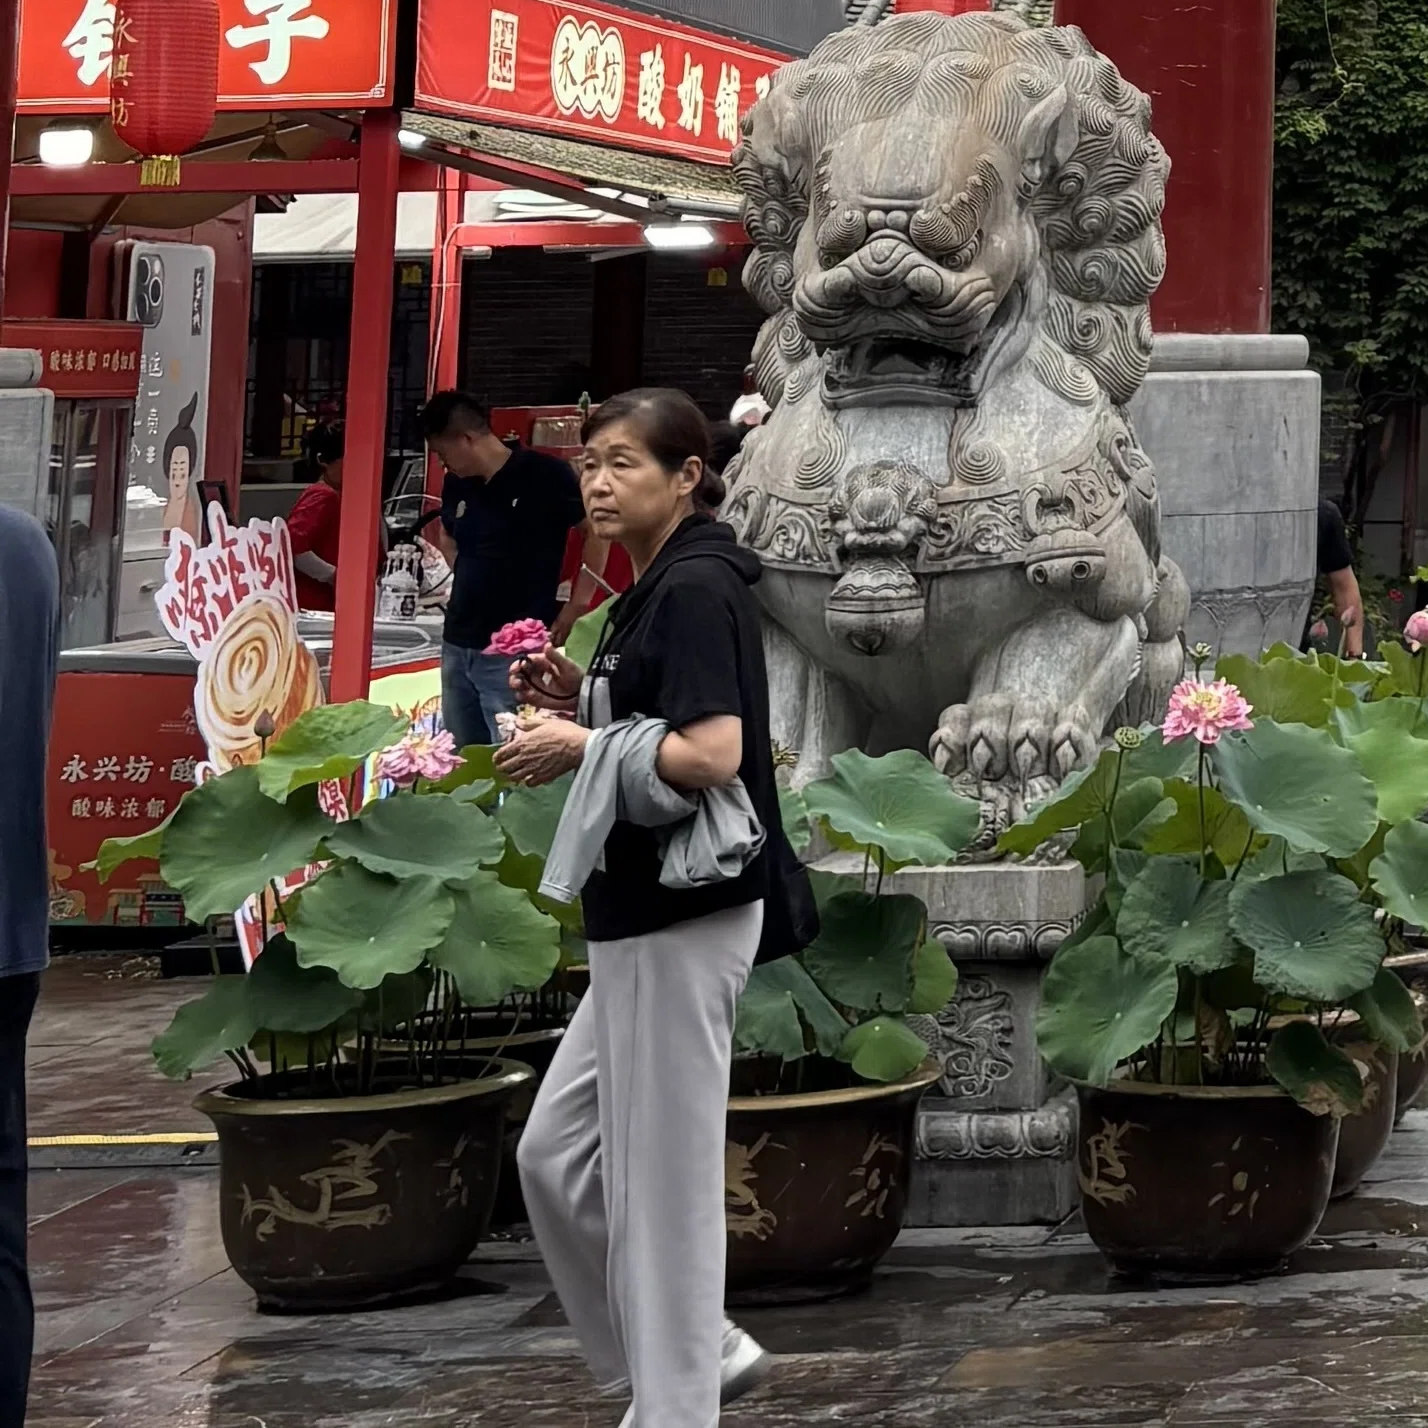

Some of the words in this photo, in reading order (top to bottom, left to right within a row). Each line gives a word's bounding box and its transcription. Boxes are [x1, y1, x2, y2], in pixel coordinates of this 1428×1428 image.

[558, 37, 621, 101] 永興坊
[638, 43, 769, 146] 酸奶铺
